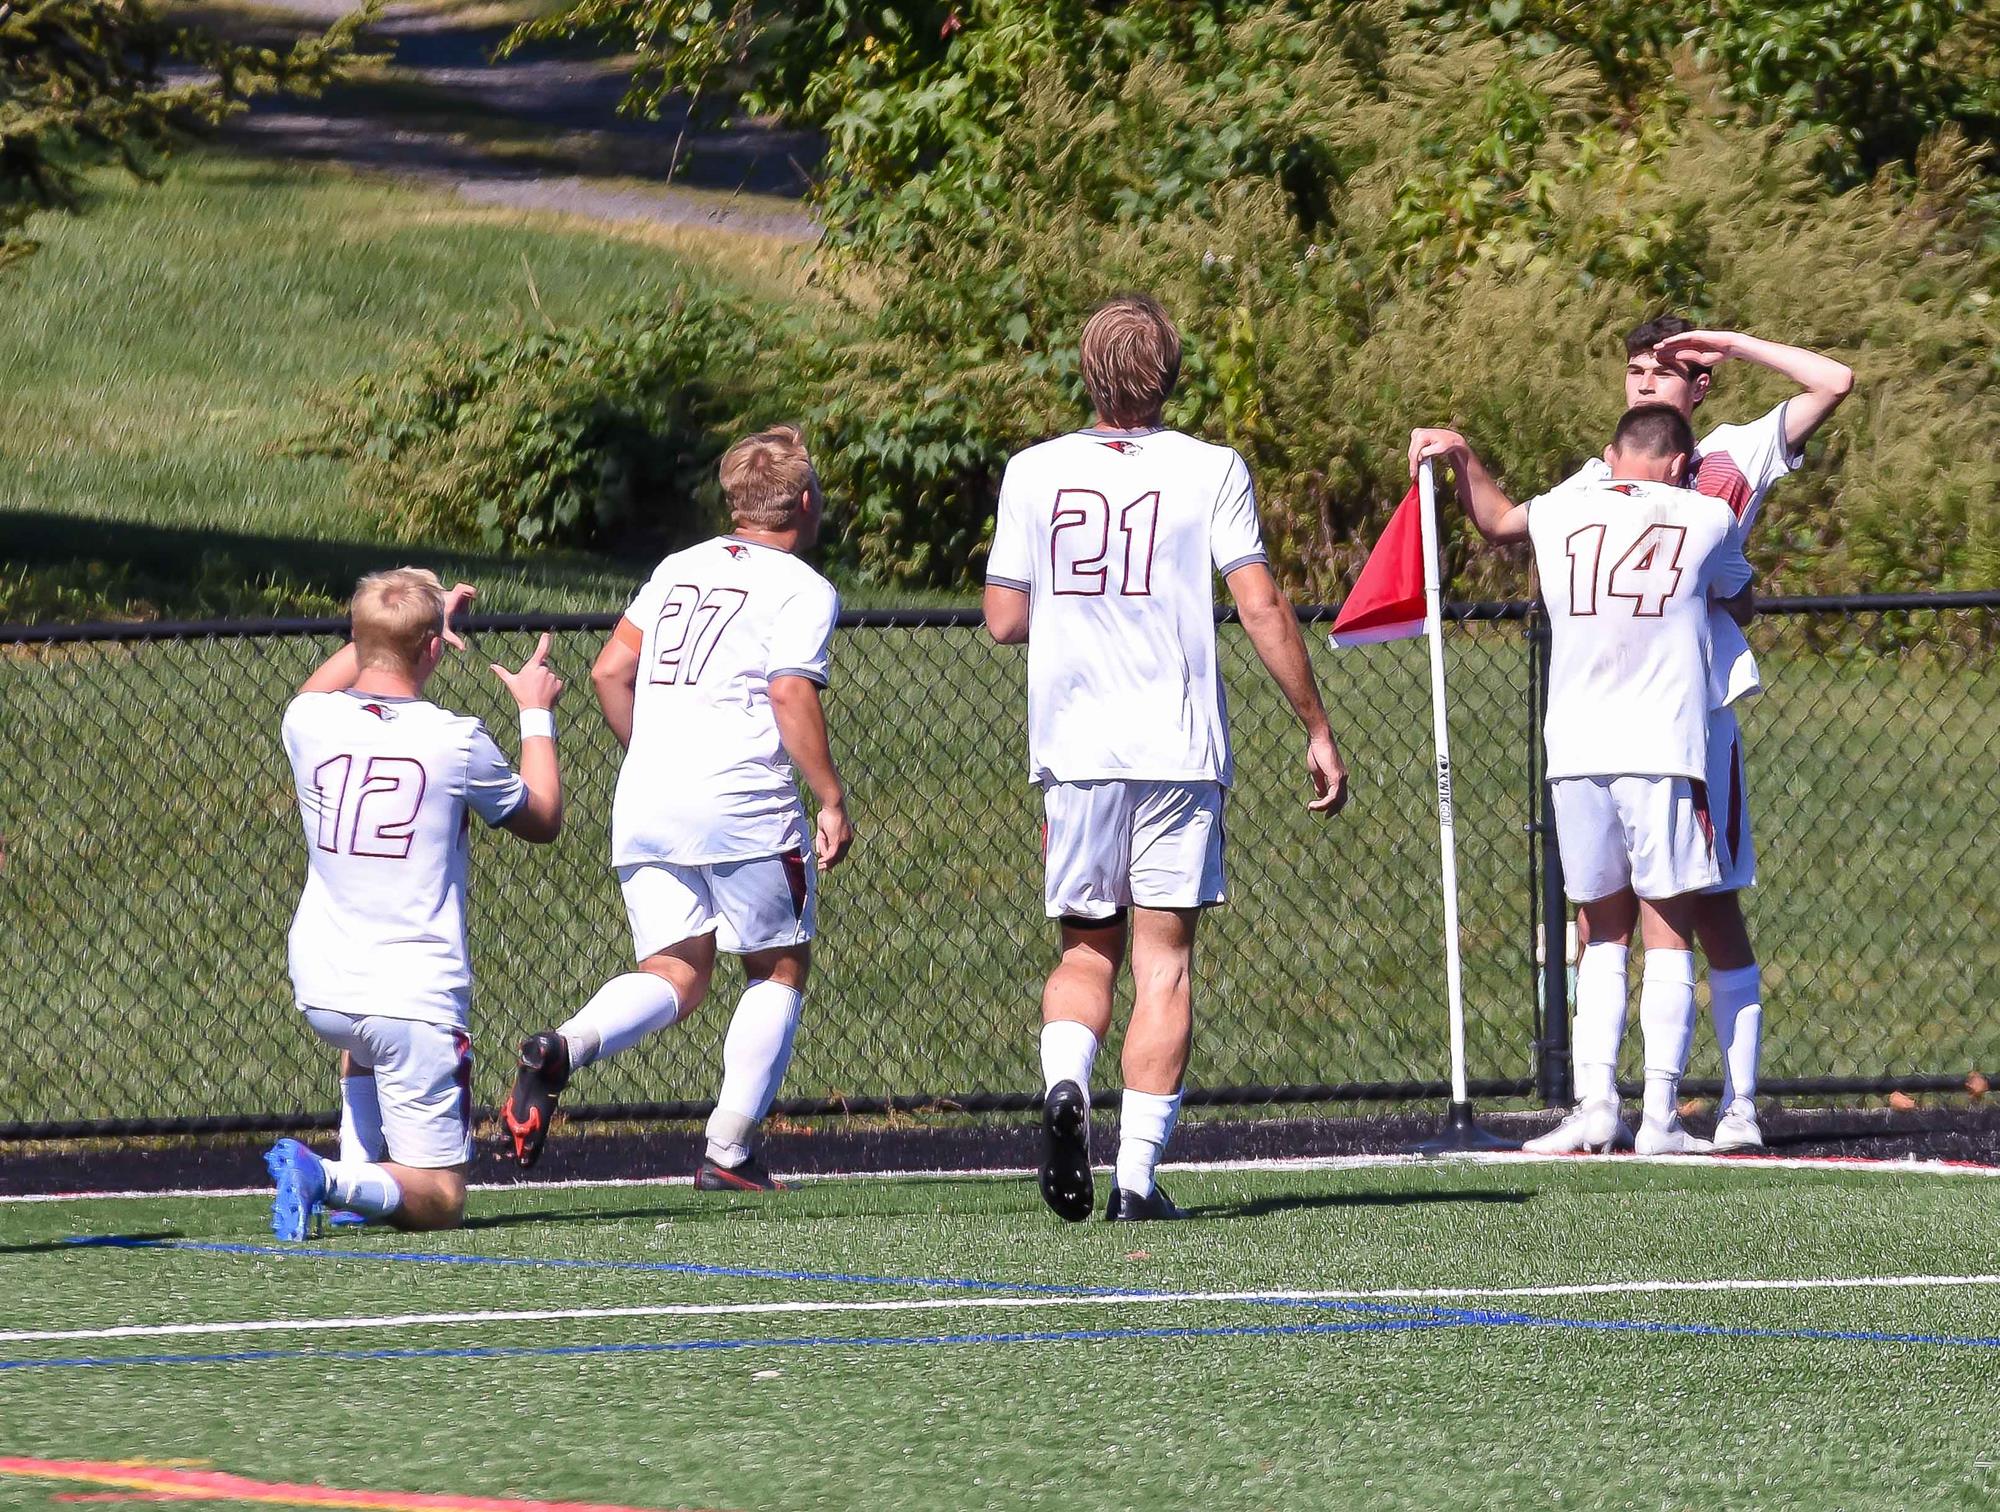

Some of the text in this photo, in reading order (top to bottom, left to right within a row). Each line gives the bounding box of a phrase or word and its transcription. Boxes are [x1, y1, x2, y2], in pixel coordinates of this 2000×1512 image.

[1050, 489, 1160, 596] 21
[1566, 523, 1687, 617] 14
[649, 584, 749, 685] 27
[314, 754, 426, 859] 12
